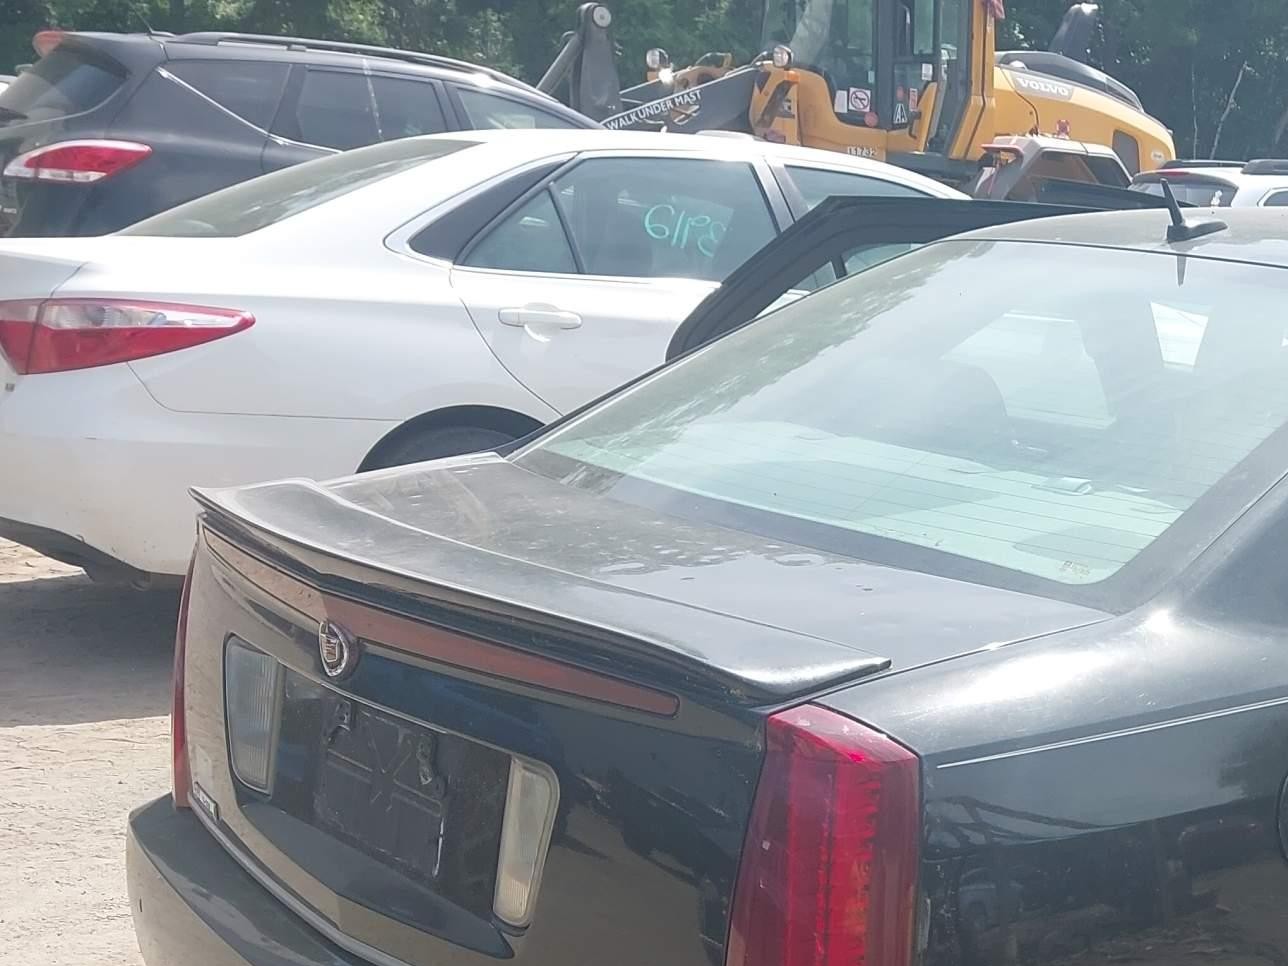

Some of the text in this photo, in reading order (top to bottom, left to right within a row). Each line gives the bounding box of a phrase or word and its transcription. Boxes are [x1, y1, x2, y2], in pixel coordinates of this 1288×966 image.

[1015, 77, 1069, 96] VOLVO
[606, 89, 703, 130] WALK UNDER MAST
